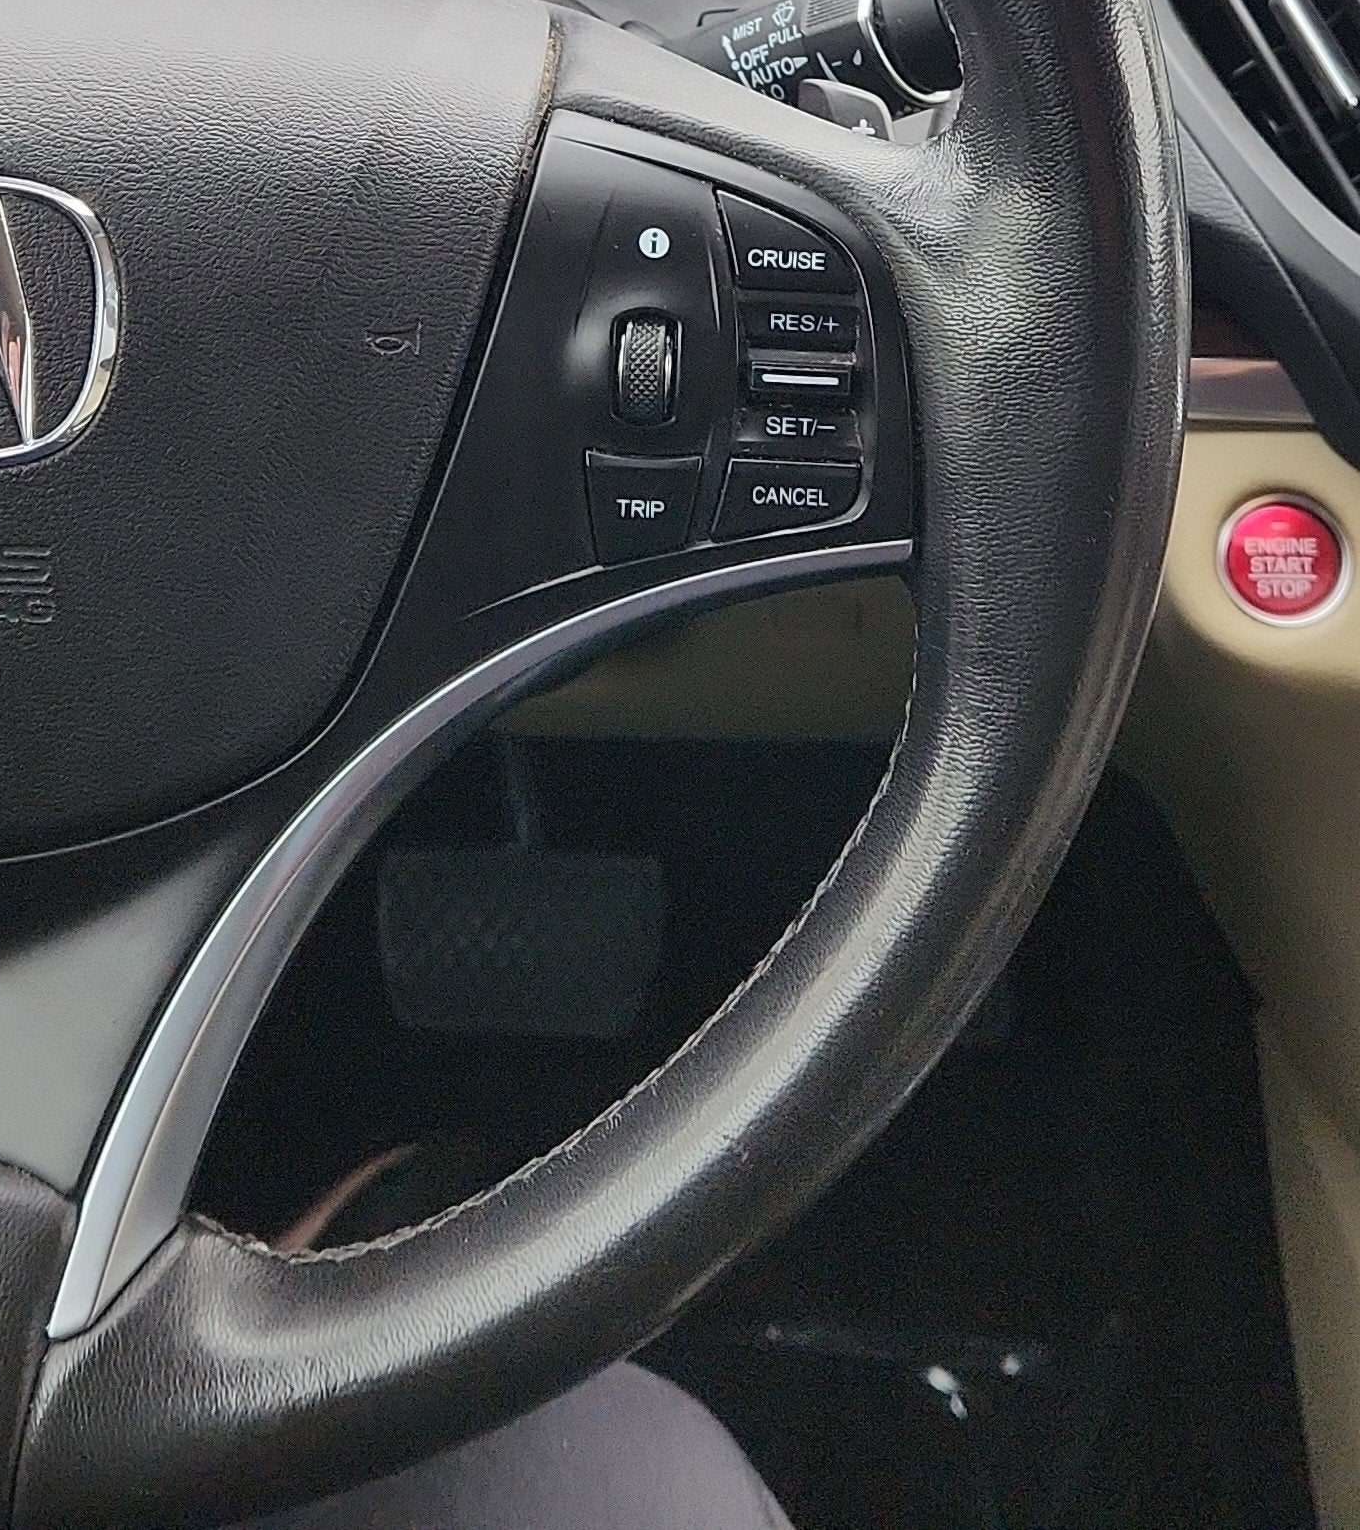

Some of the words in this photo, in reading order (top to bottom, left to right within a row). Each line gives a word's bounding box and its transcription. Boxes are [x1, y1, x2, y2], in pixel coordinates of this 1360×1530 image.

[731, 16, 764, 42] MIST
[767, 22, 804, 51] PULL
[740, 42, 770, 72] OFF
[751, 55, 794, 89] AUTO
[747, 249, 826, 271] CRUISE
[770, 312, 840, 334] RES/+
[751, 486, 830, 508] CANCEL
[616, 499, 666, 520] TRIP
[1244, 537, 1318, 558] ENGINE
[1250, 556, 1314, 575] START
[1256, 579, 1314, 598] STOP
